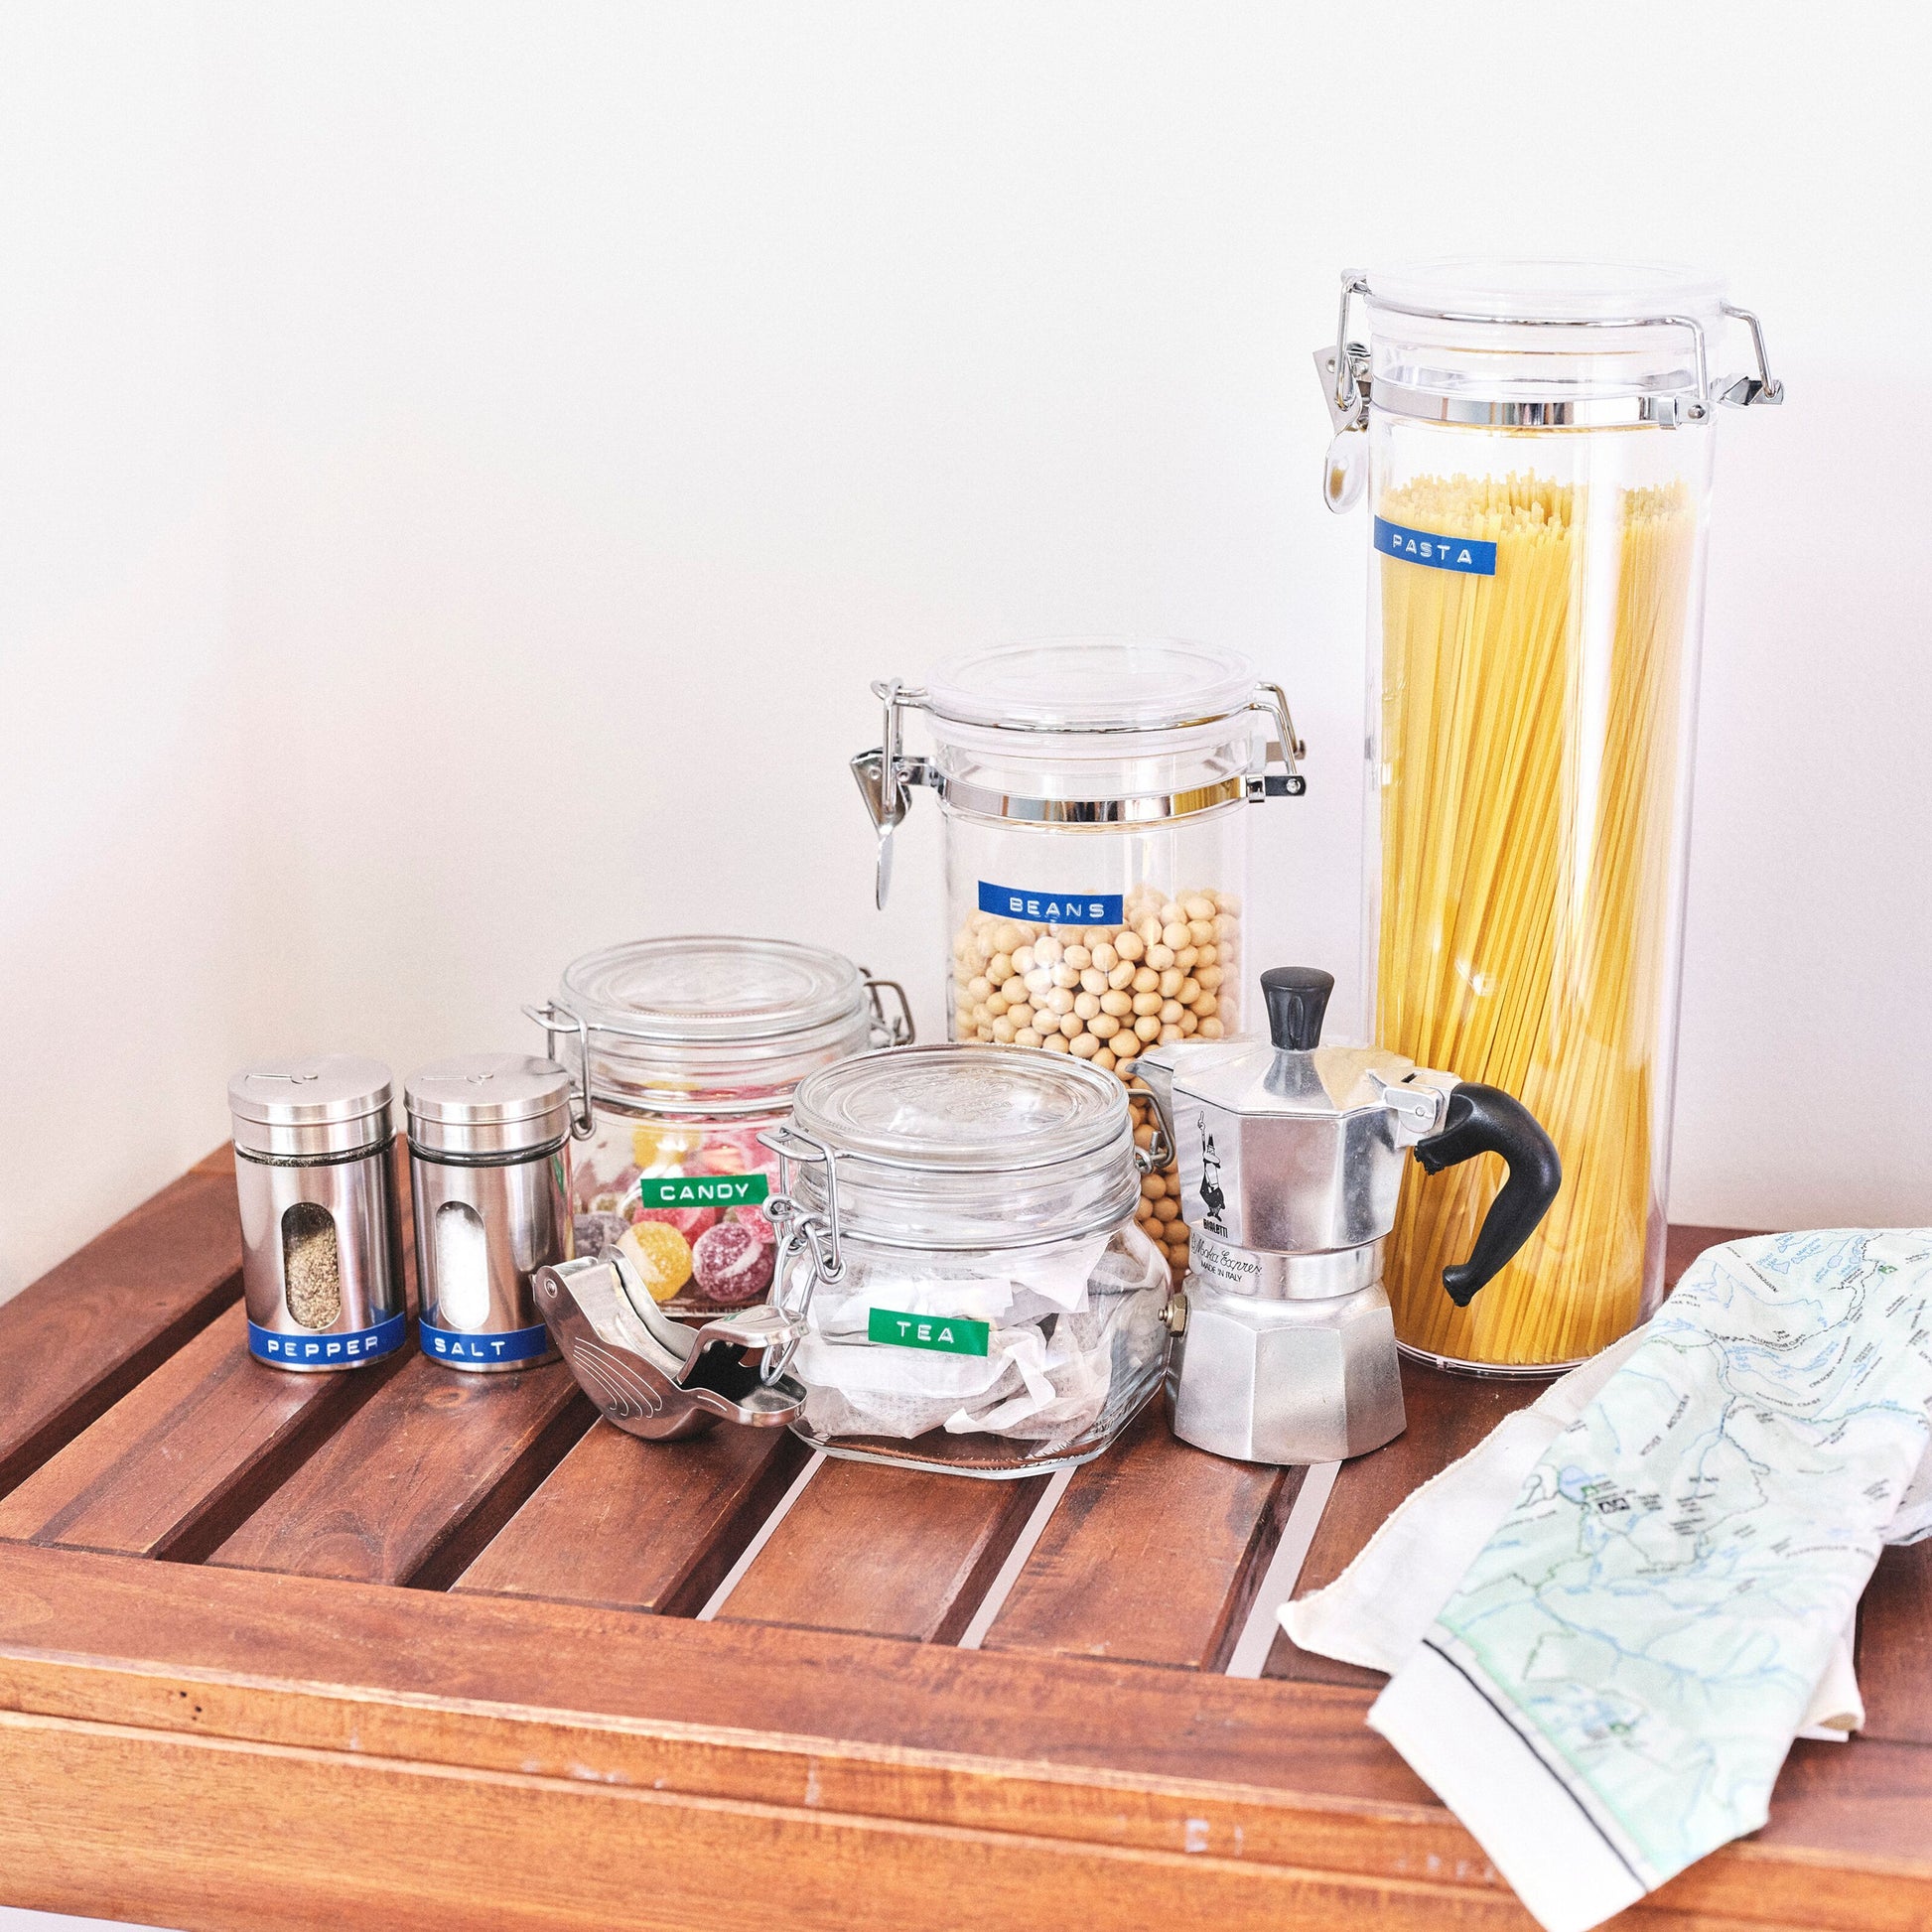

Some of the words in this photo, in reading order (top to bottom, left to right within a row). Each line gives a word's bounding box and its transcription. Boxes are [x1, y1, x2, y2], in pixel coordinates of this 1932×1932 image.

[1392, 533, 1472, 565] PASTA
[1009, 897, 1105, 918] BEANS
[659, 1182, 750, 1201] CANDY
[1202, 1217, 1229, 1239] BIALETTI
[1200, 1259, 1217, 1275] MADE
[1217, 1268, 1225, 1278] IN
[1225, 1271, 1243, 1283] ITALY
[896, 1320, 954, 1344] TEA
[267, 1335, 378, 1358] PEPPER
[434, 1337, 506, 1357] SALT
